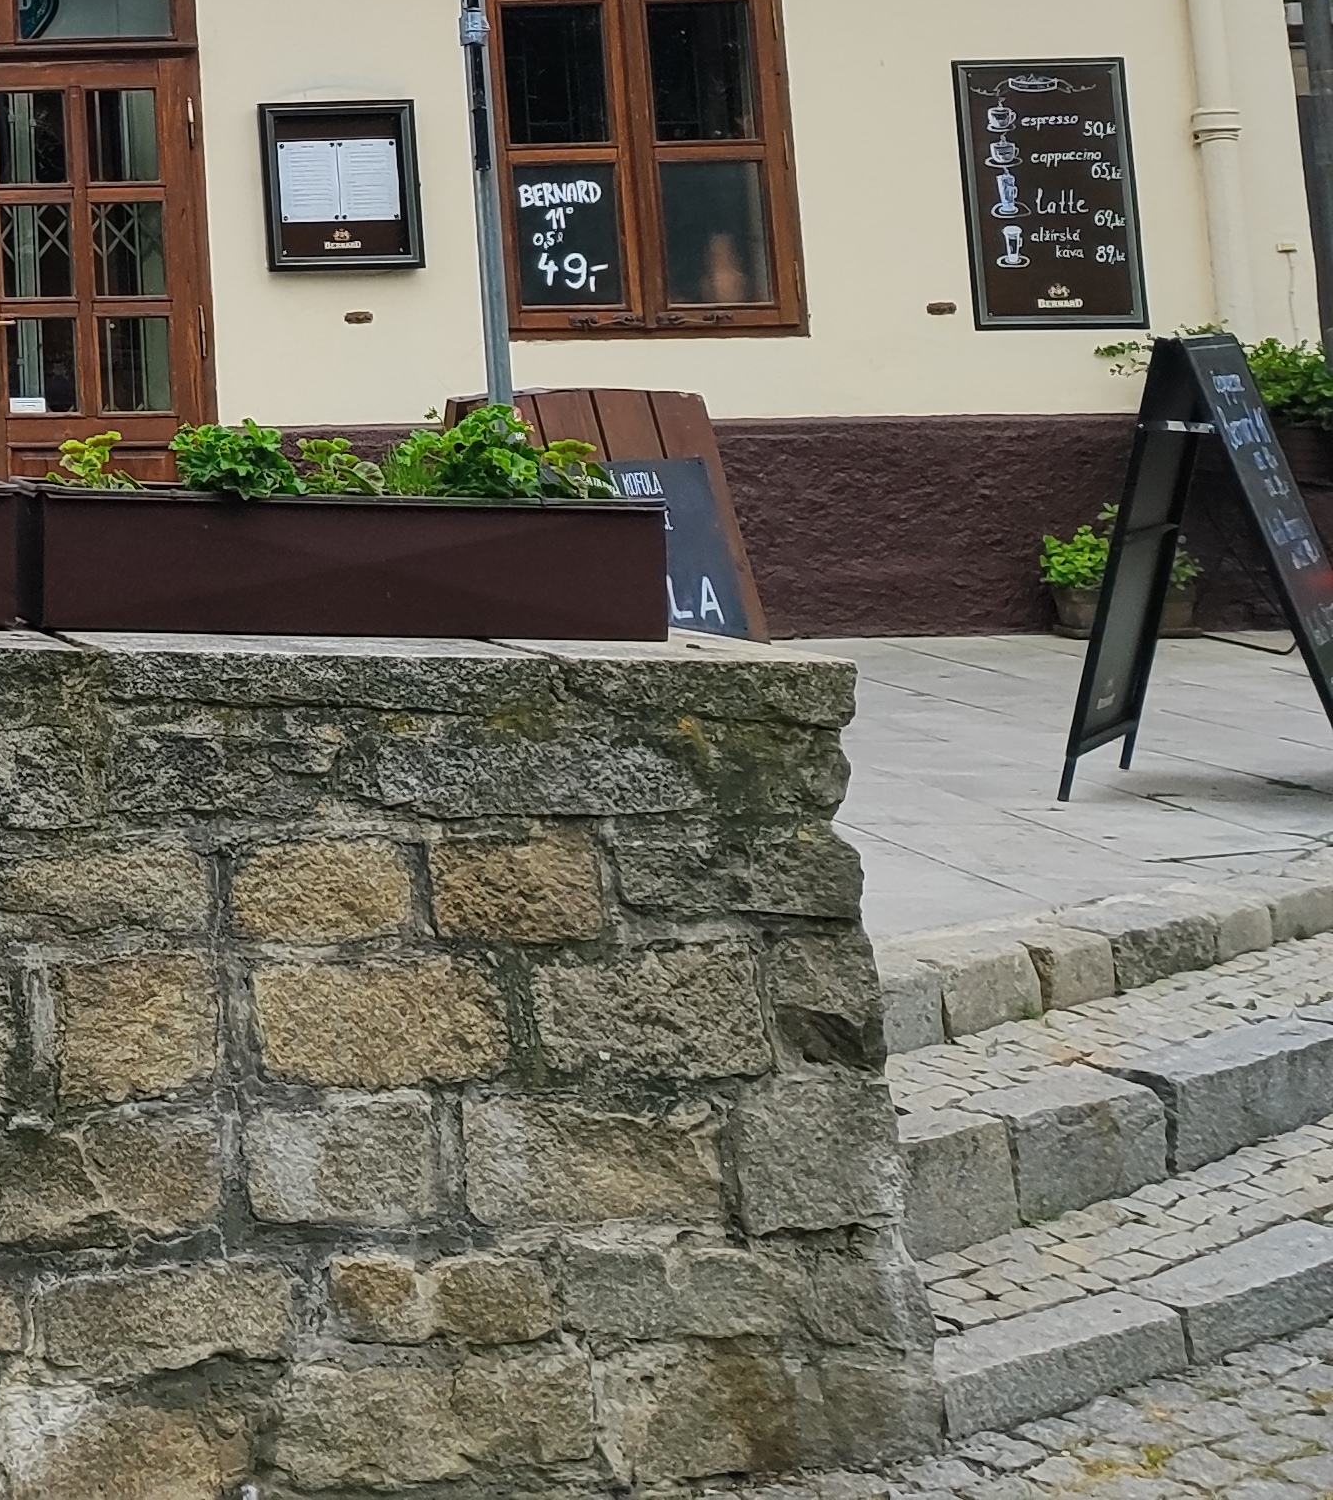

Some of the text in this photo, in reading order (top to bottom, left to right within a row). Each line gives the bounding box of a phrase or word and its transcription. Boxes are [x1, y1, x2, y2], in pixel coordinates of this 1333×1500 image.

[1021, 115, 1079, 131] espresso
[1030, 149, 1102, 168] cappuccino
[518, 179, 602, 208] BERNARD
[621, 470, 664, 497] KOFOLA
